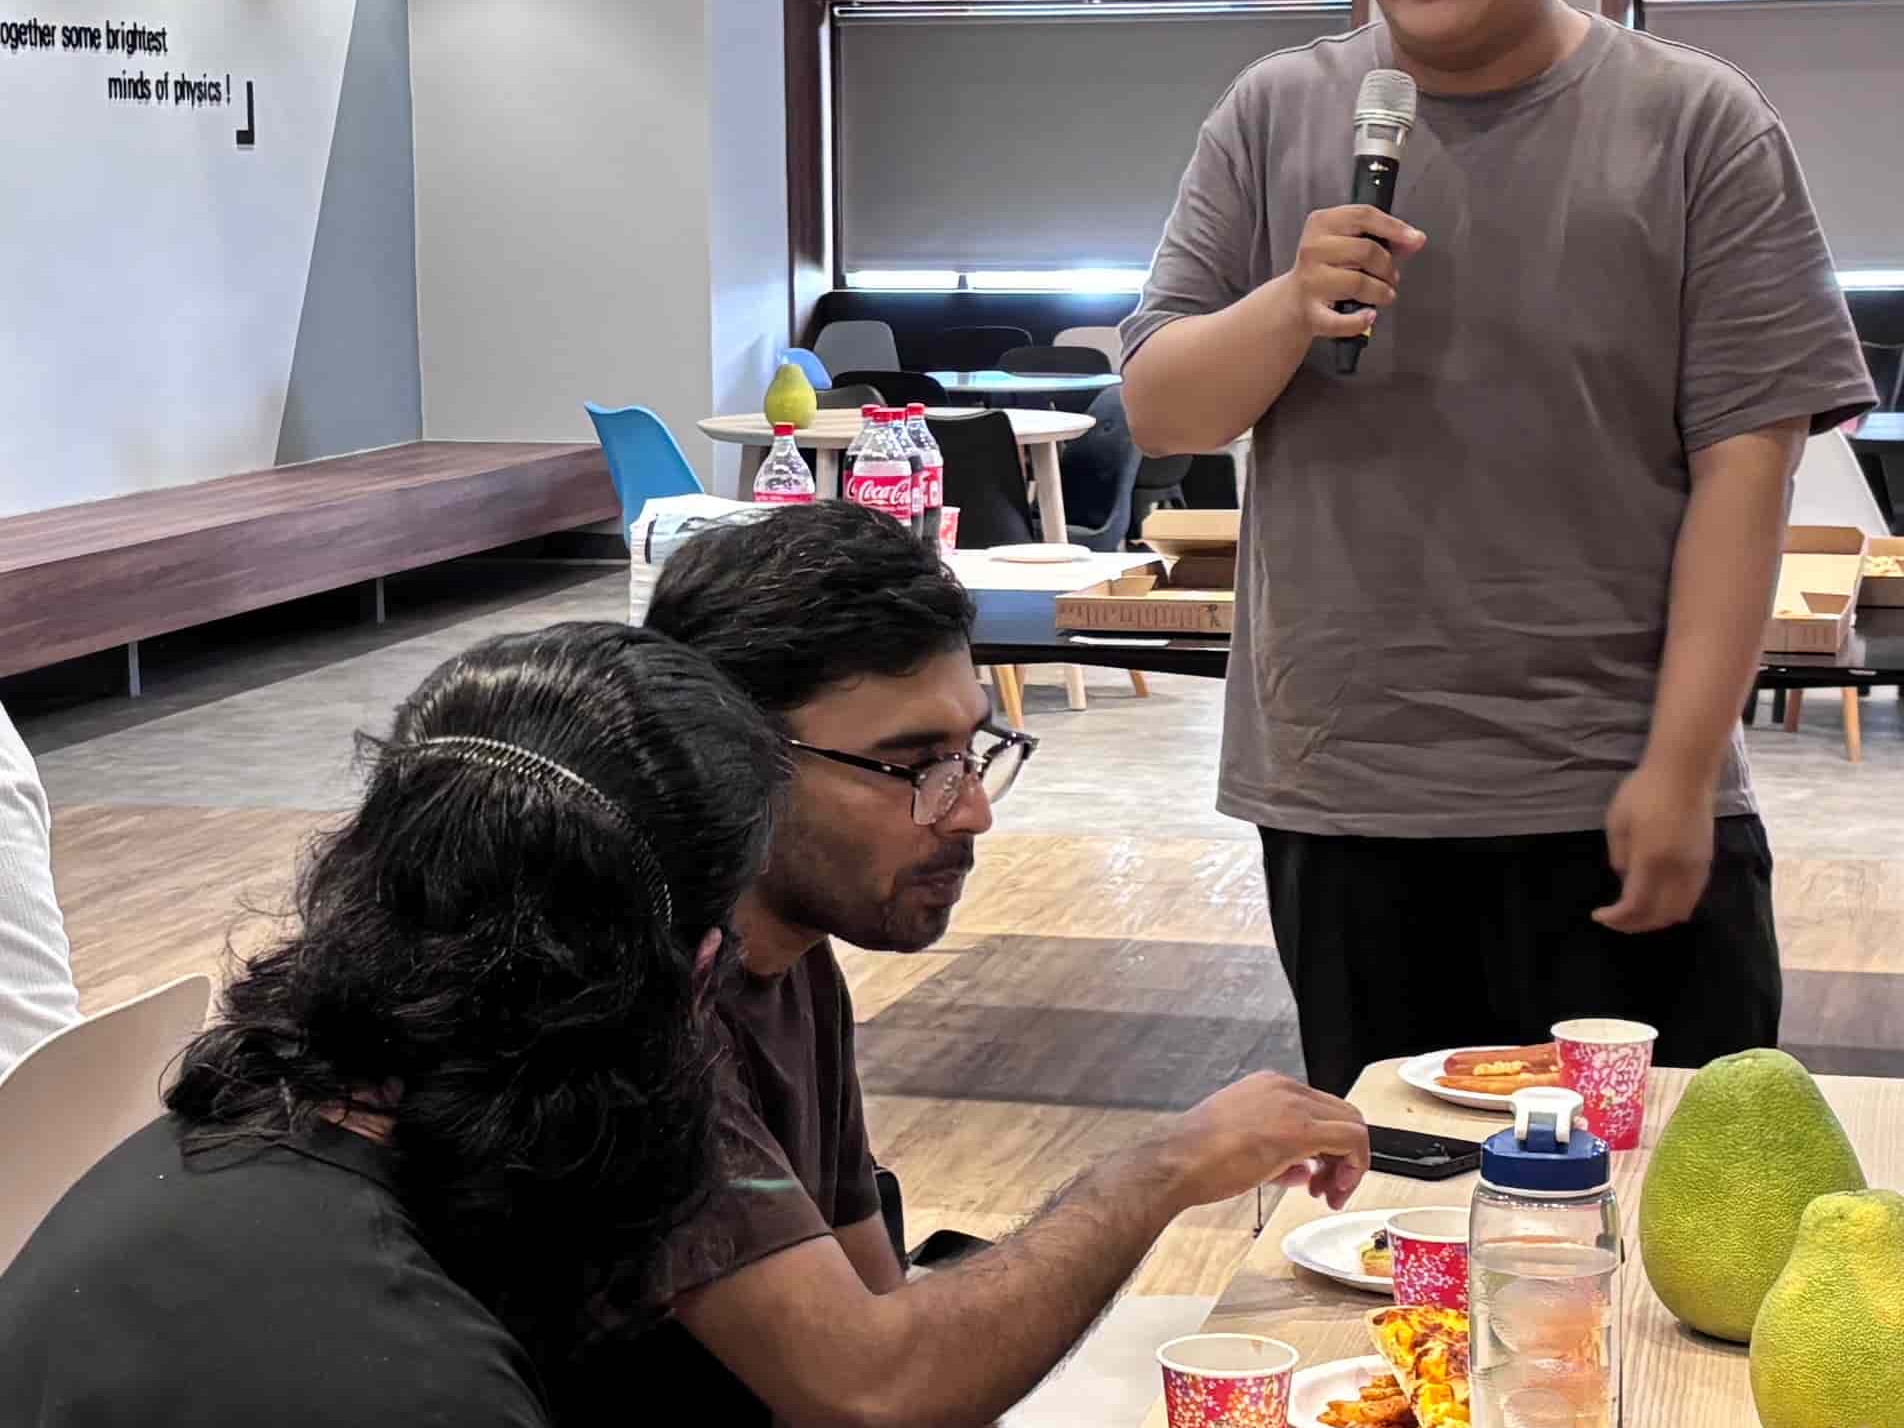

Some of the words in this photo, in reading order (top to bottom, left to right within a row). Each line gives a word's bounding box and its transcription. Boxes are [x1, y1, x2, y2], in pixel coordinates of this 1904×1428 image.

[62, 25, 102, 50] some
[106, 20, 168, 56] brightest
[108, 70, 151, 101] minds
[155, 72, 169, 101] of
